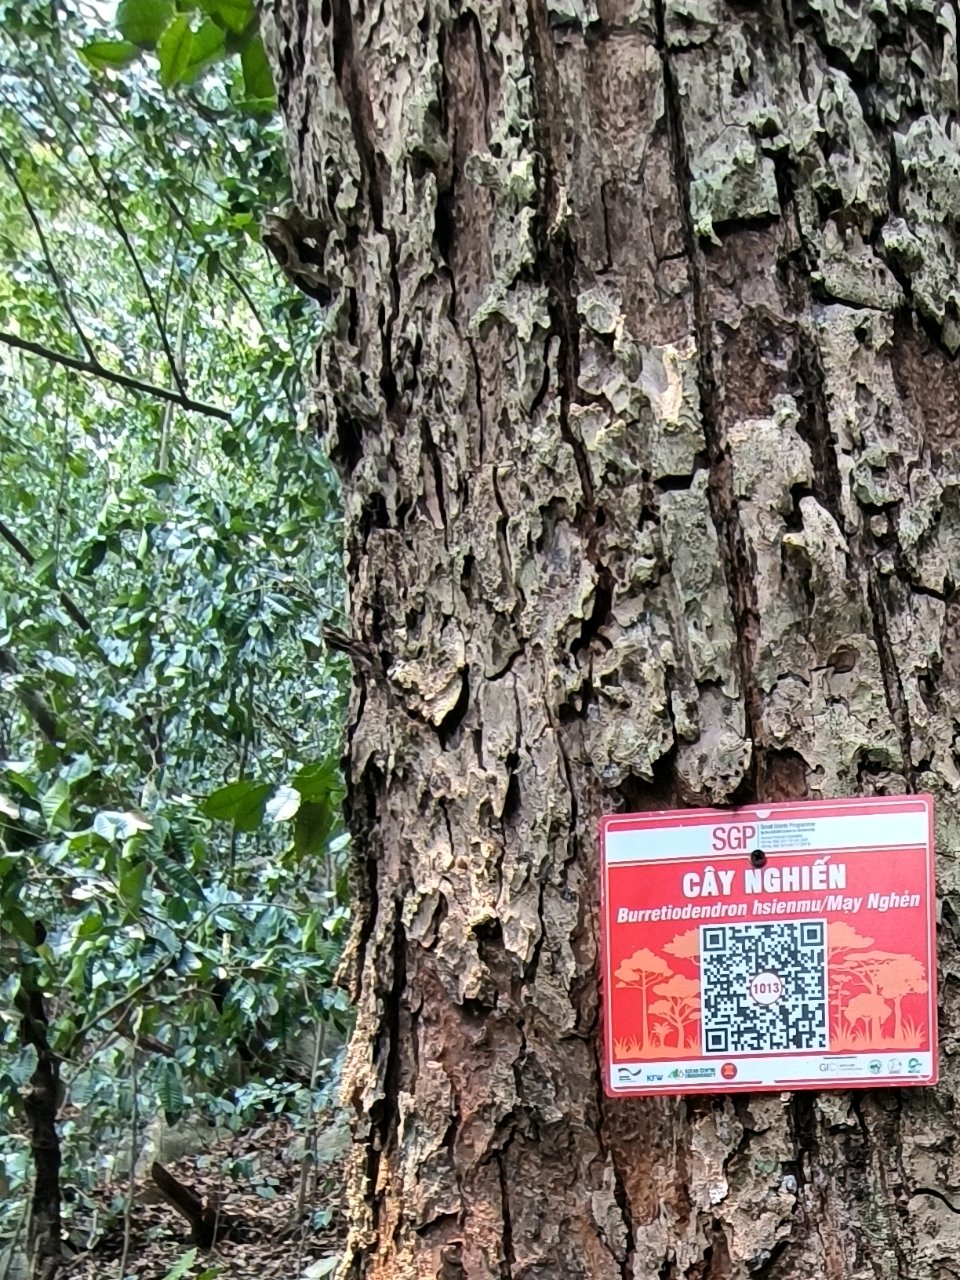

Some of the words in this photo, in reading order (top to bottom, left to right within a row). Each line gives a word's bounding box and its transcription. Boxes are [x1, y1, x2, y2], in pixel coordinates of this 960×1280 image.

[712, 825, 756, 851] SGP
[683, 865, 736, 898] CÂY
[744, 855, 846, 894] NGHIẾN
[617, 901, 747, 923] Burretiodendron
[752, 895, 863, 915] hsienmu/Mạy
[753, 982, 780, 994] 1013
